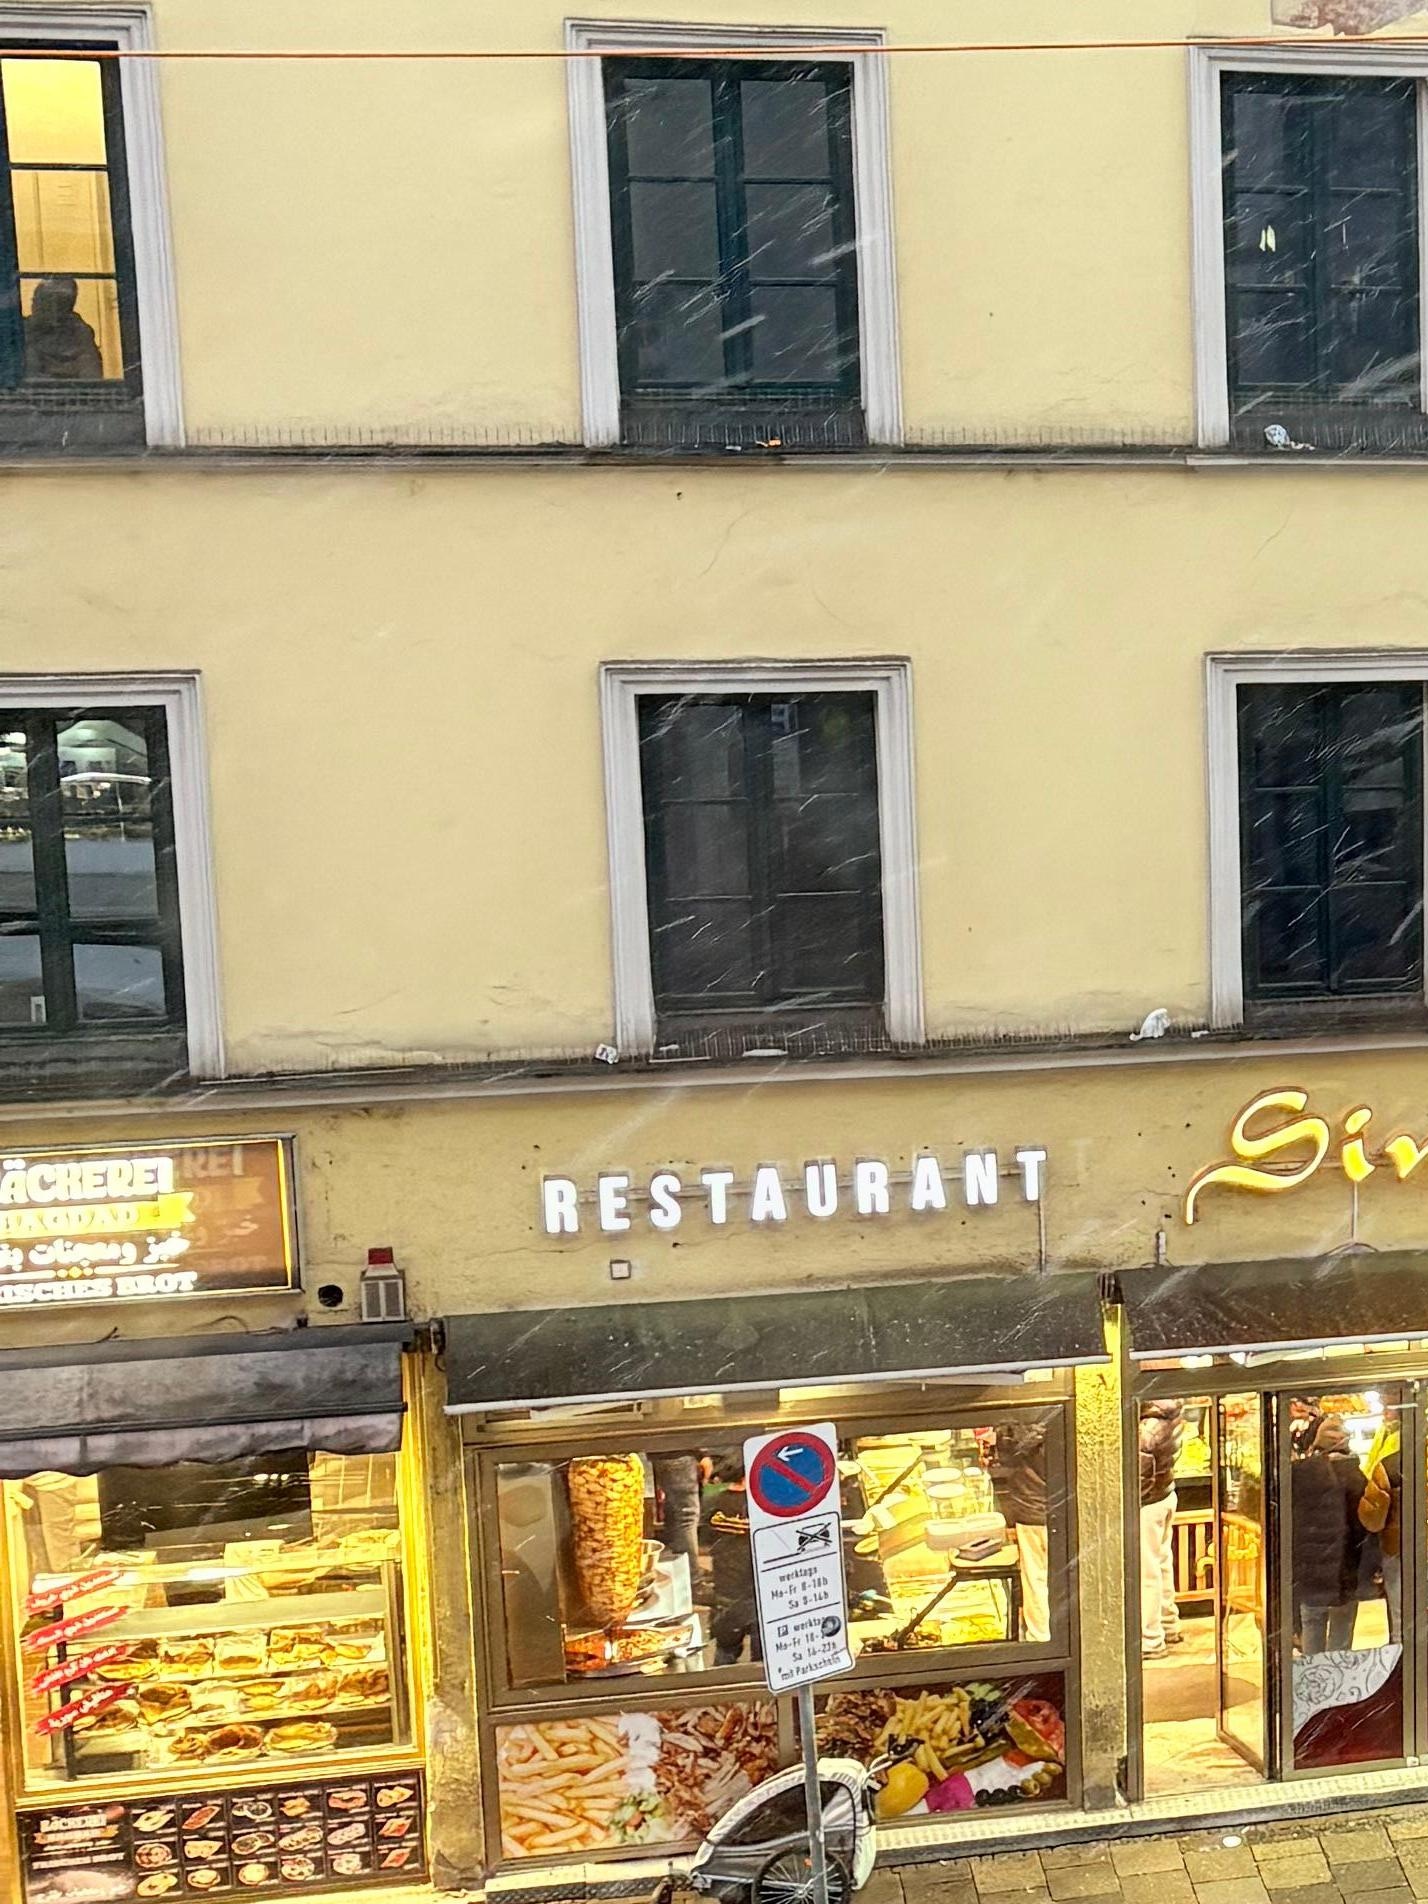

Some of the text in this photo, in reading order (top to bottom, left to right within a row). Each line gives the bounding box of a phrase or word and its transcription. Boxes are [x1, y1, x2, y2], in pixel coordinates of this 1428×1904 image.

[542, 1146, 1049, 1235] RESTAURANT
[778, 1566, 818, 1583] werktags
[771, 1584, 797, 1600] Mo-Fr
[788, 1599, 799, 1610] Sa
[793, 1616, 826, 1632] werkta
[775, 1637, 801, 1653] Mo-Fr
[792, 1652, 803, 1663] Sa
